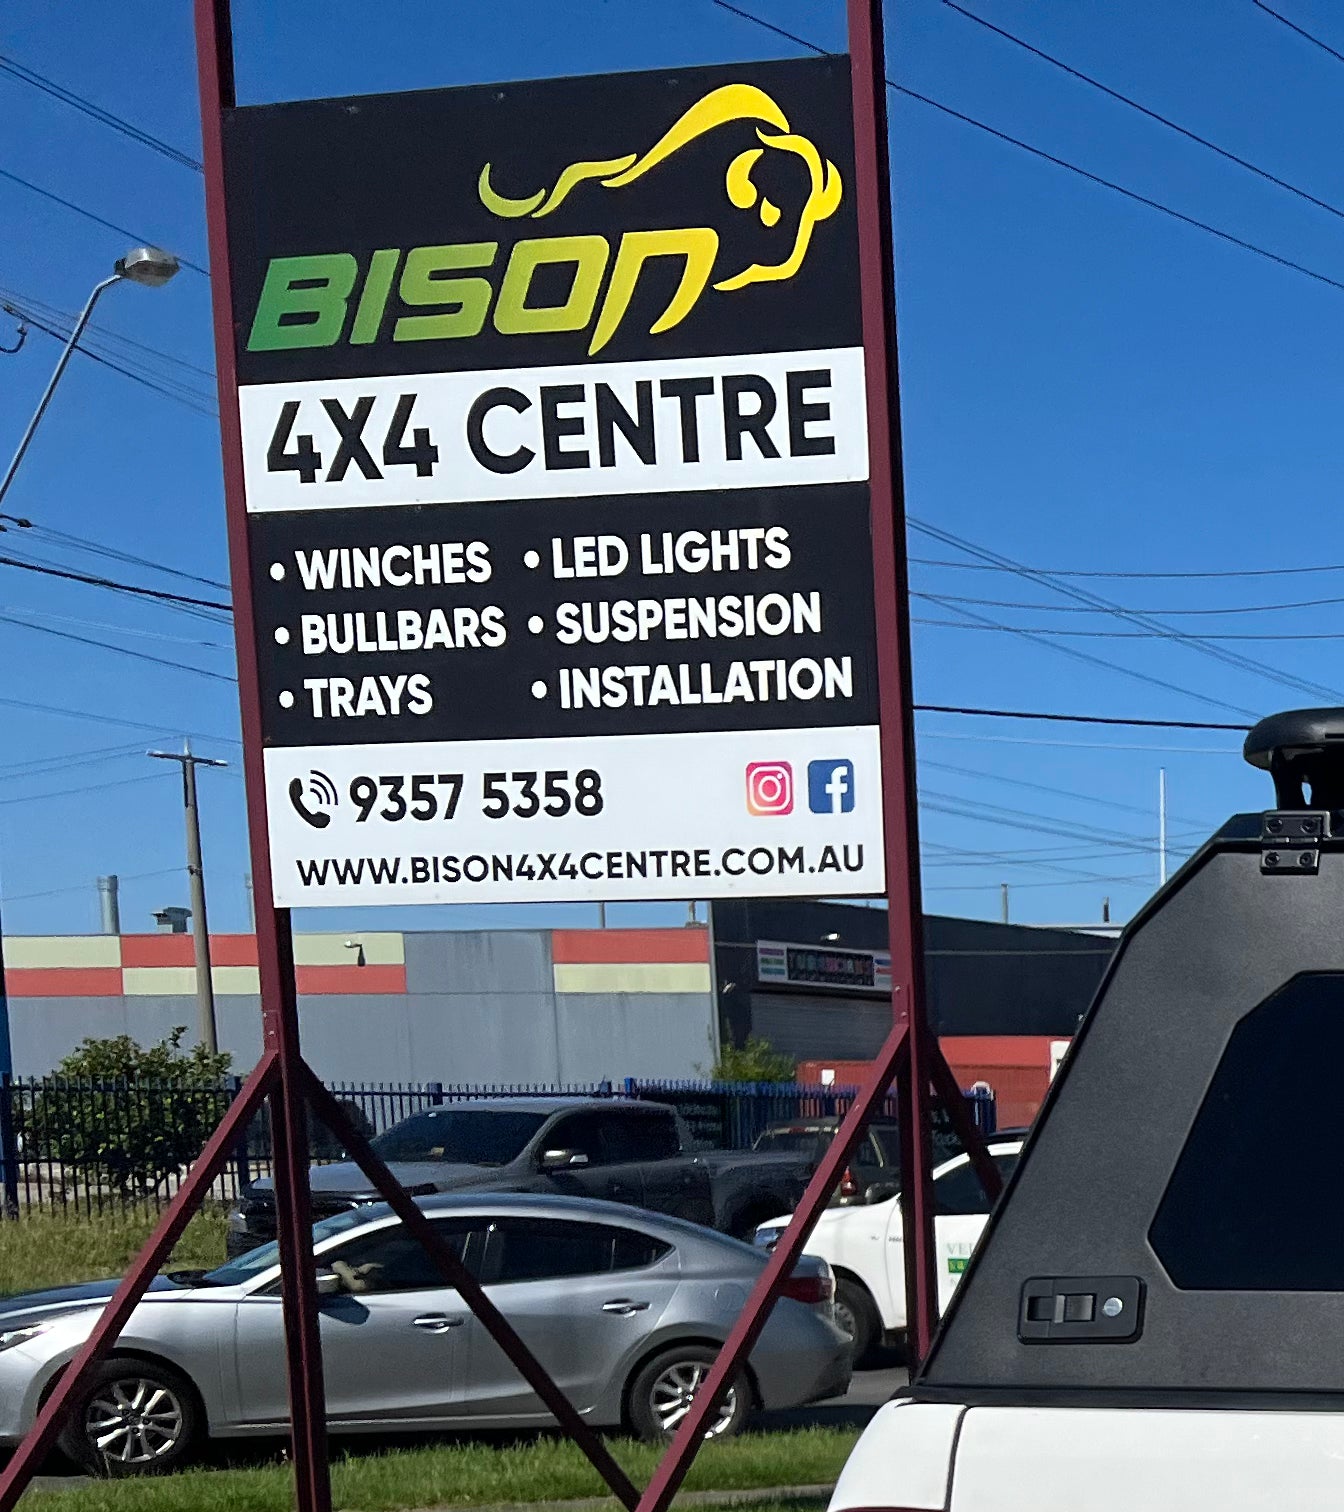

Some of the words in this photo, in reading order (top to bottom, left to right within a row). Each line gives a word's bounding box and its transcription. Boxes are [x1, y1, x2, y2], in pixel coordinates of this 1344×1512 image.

[267, 394, 438, 484] 4X4
[467, 369, 836, 475] CENTRE
[295, 542, 492, 590] WINCHES
[552, 535, 628, 579] LED
[641, 526, 791, 574] LIGHTS
[301, 606, 506, 654] BULLBARS
[555, 591, 821, 644] SUSPENSION
[304, 674, 433, 718] TRAYS
[559, 656, 853, 709] INSTALLATION
[349, 773, 462, 822] 9357
[483, 769, 603, 818] 5358
[296, 844, 864, 887] WWW.BISON4X4CENTRE.COM.AU
